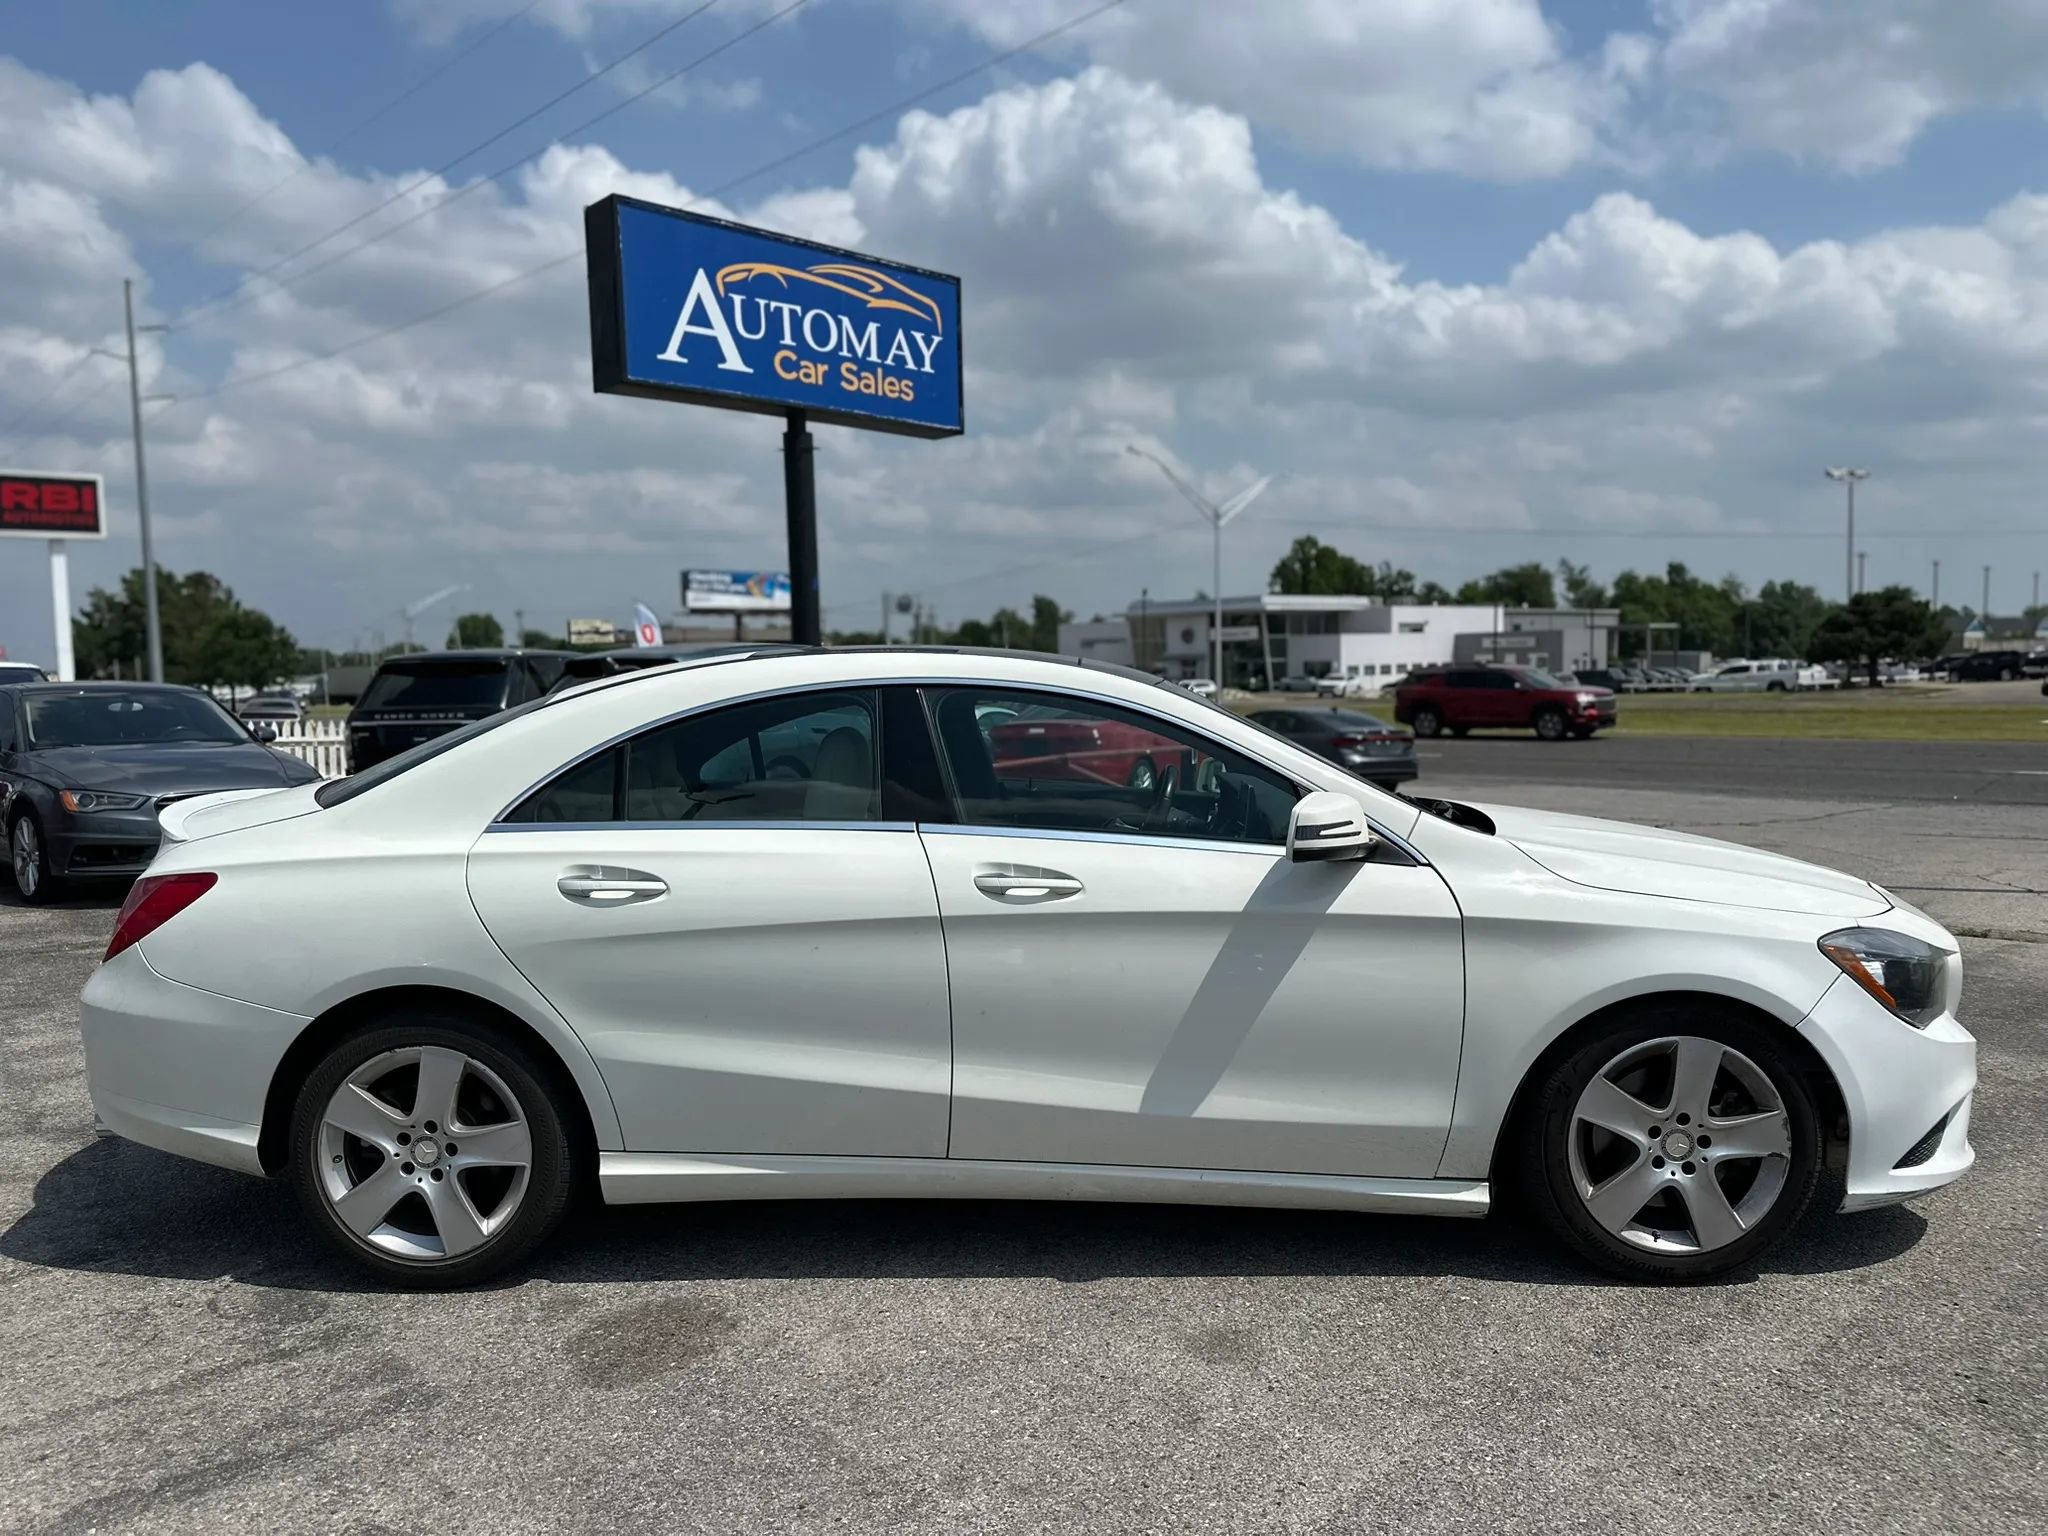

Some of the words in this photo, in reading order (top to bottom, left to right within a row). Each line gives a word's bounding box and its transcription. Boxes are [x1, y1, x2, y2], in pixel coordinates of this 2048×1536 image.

[657, 268, 943, 373] AUTOMAY
[774, 350, 828, 385] Car
[840, 362, 915, 402] Sales
[1, 482, 95, 513] RBI
